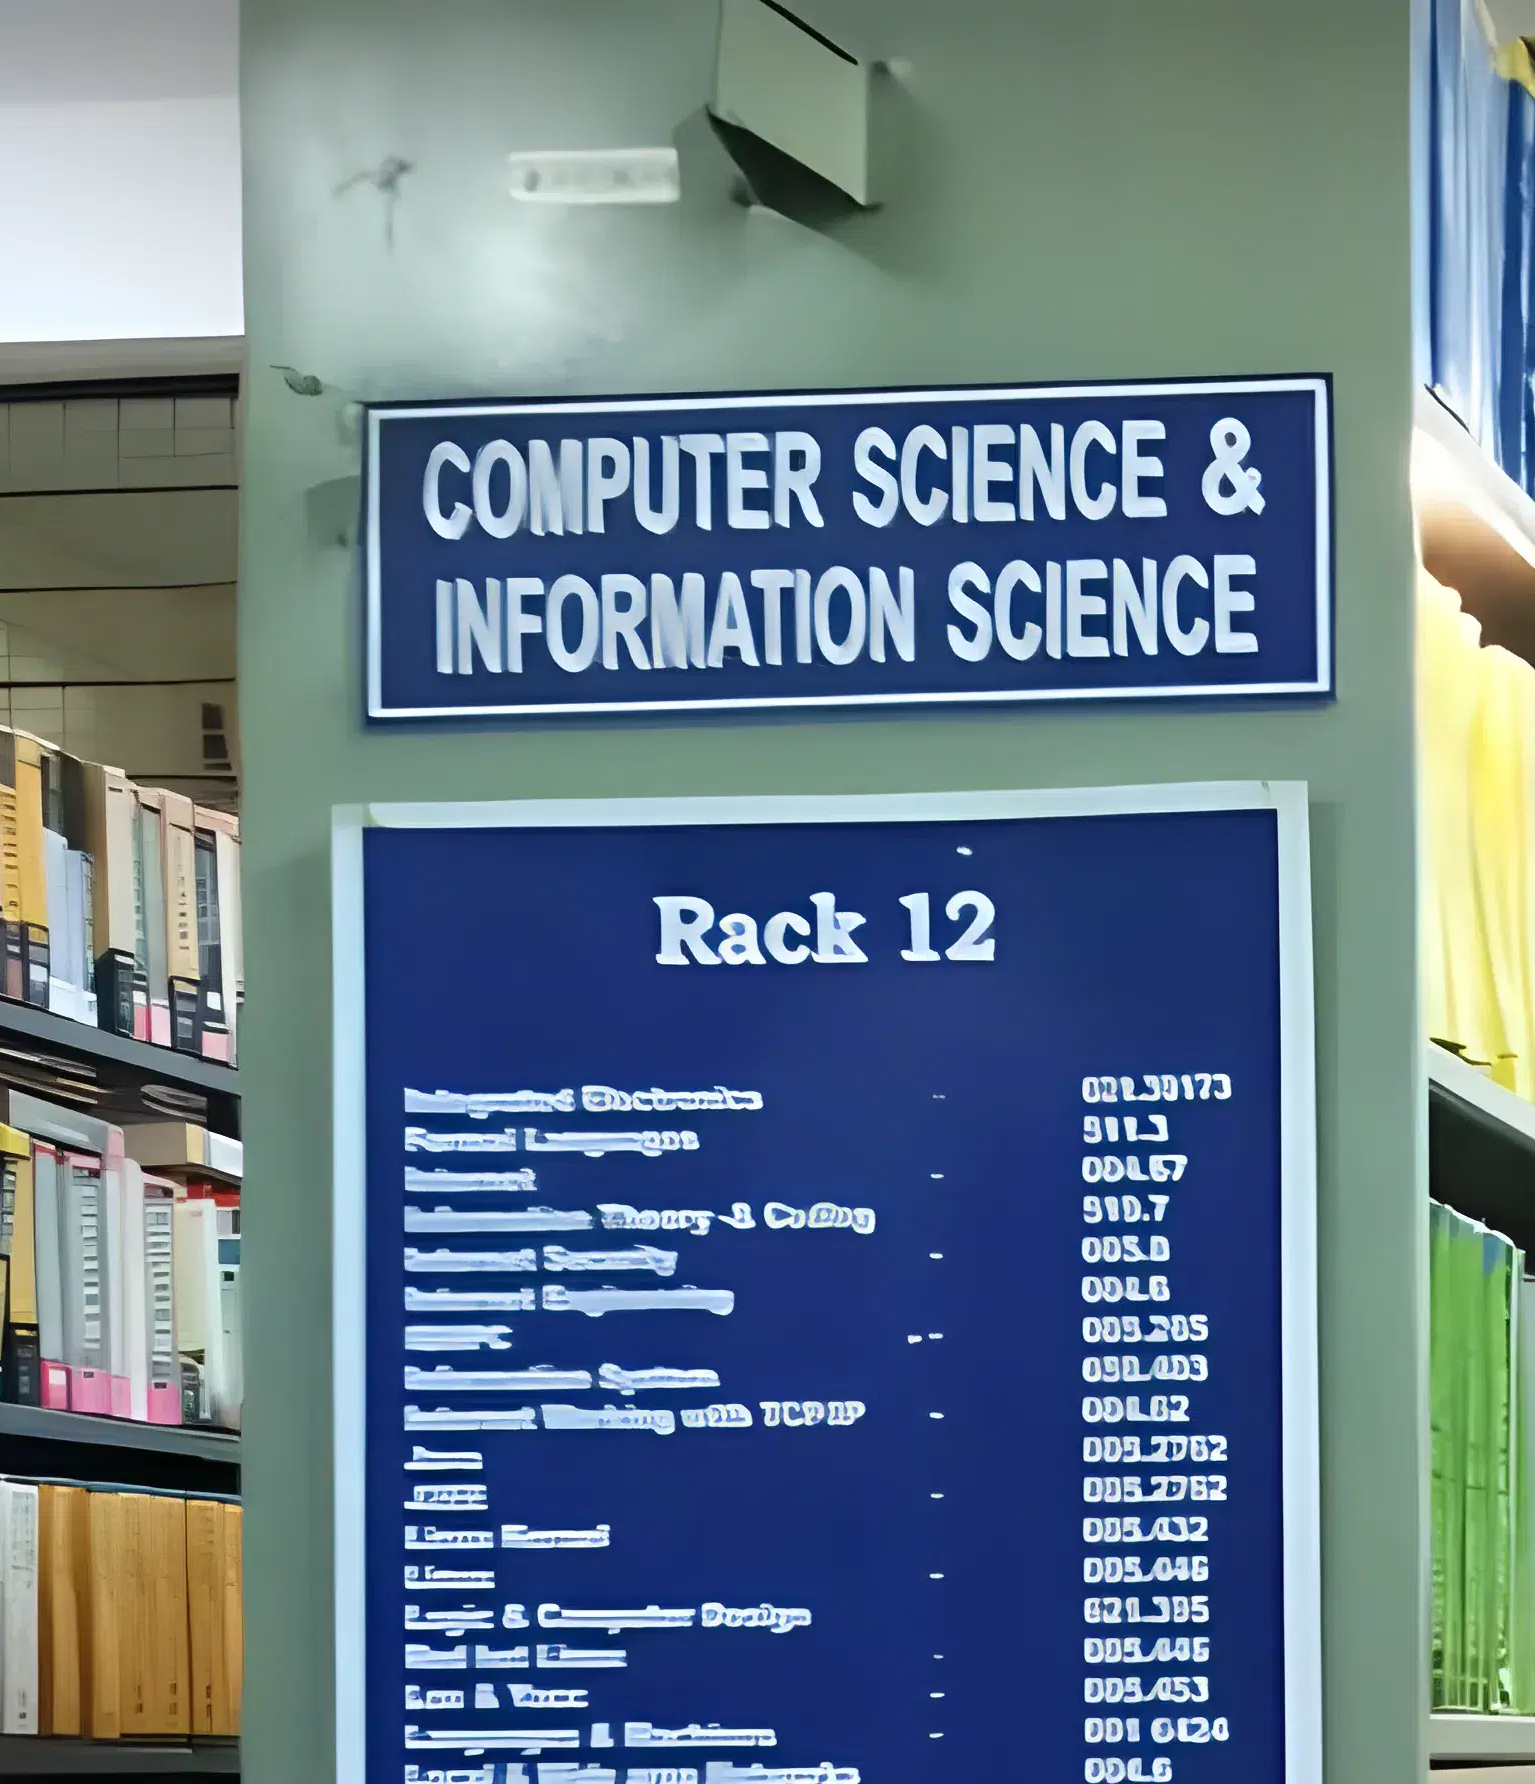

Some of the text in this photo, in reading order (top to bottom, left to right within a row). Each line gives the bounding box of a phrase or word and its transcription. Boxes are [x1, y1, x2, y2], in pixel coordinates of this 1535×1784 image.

[421, 415, 1267, 541] COMPUTER SCIENCE &
[434, 552, 1259, 676] INFORMATION SCIENCE
[651, 889, 997, 967] Rack 12
